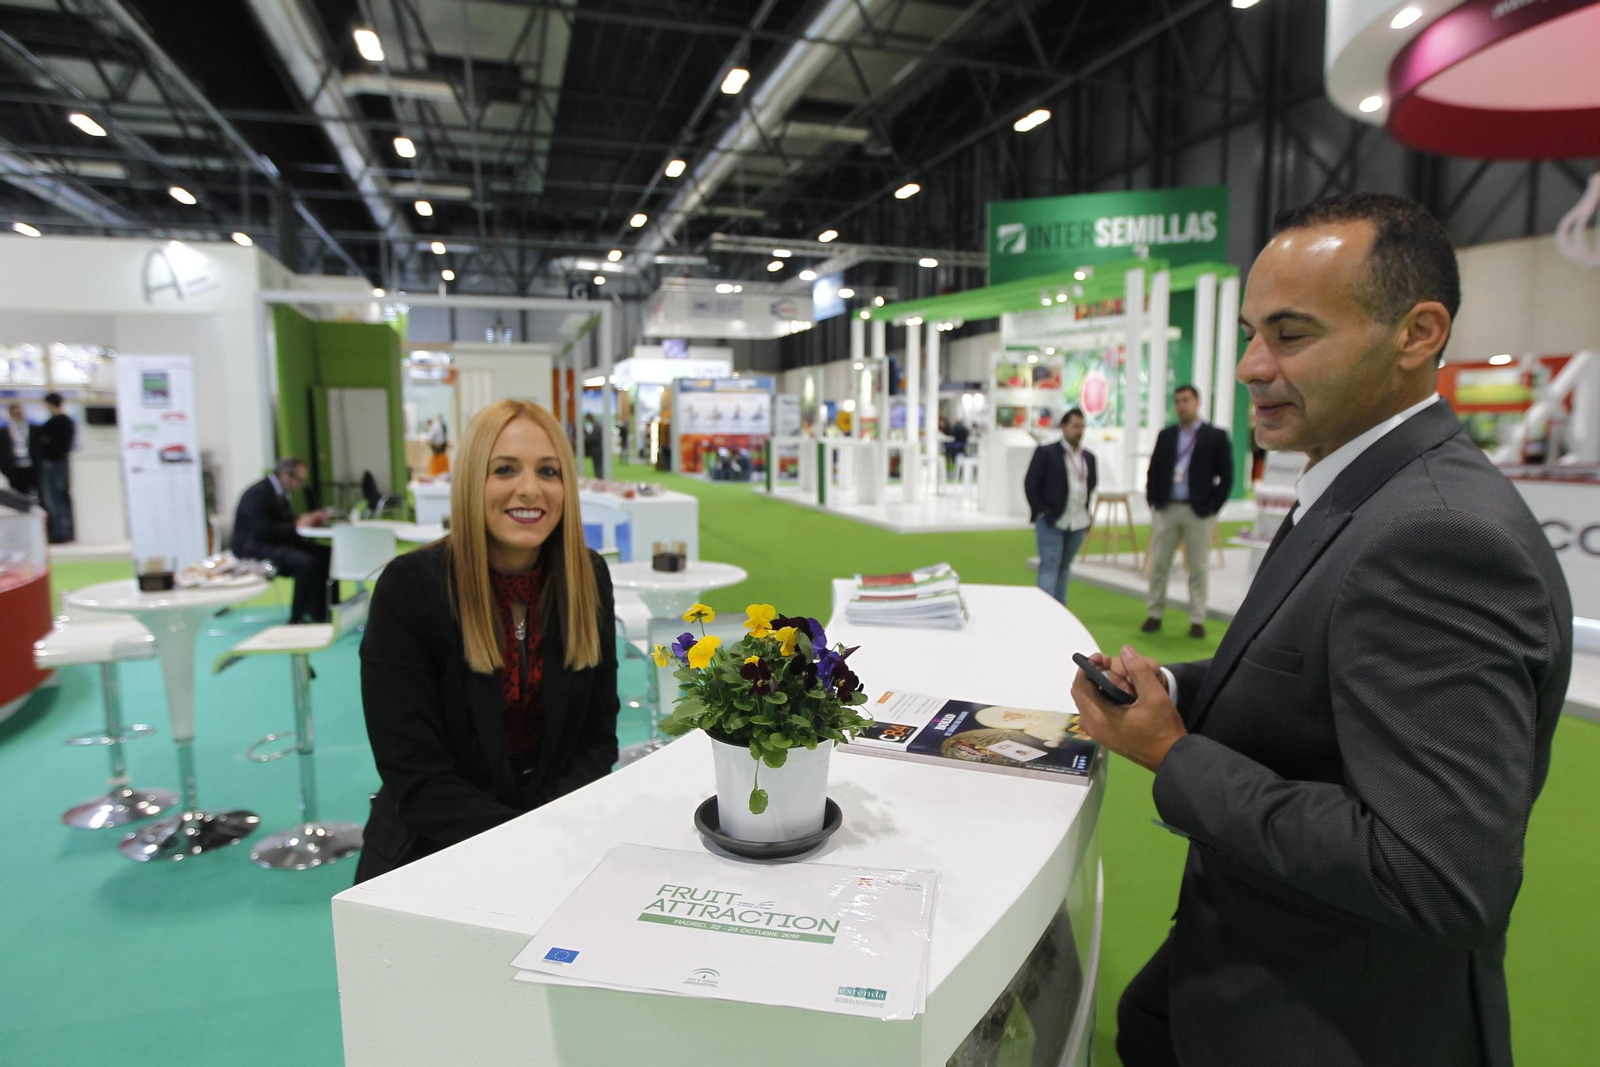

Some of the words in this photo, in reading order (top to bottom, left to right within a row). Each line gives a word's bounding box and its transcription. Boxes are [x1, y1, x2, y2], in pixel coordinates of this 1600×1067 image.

[656, 884, 742, 906] FRUIT
[644, 898, 841, 933] ATTRACTION
[740, 928, 779, 937] OCTUBRE
[839, 988, 884, 999] extenda
